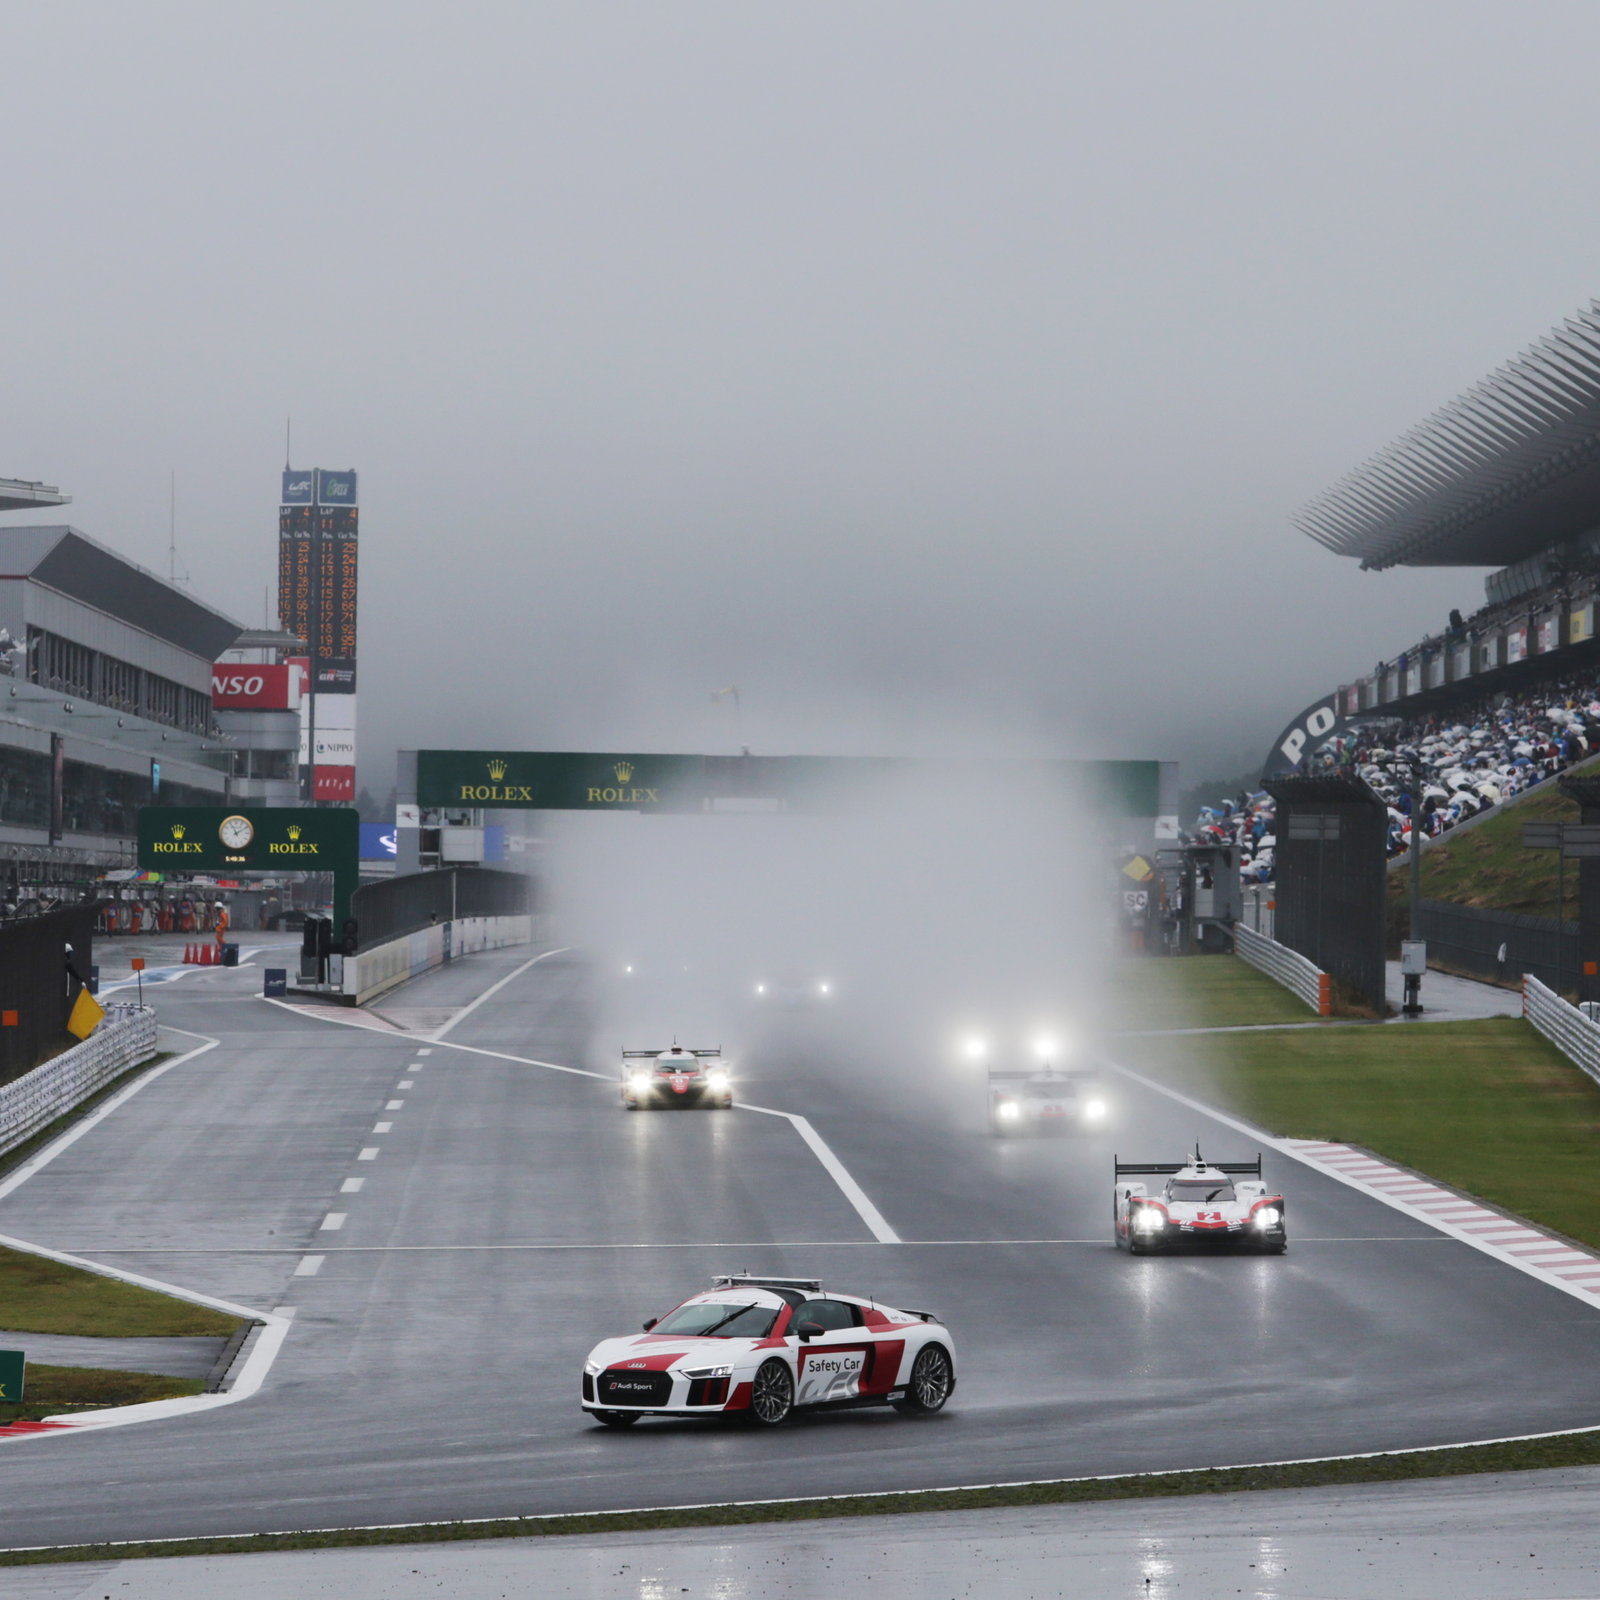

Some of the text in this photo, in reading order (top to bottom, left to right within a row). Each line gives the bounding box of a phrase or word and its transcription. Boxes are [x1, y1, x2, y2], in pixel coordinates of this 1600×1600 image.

[327, 743, 353, 752] NIPPO
[461, 785, 533, 800] ROLEX
[587, 787, 659, 802] ROLEX
[153, 842, 203, 853] ROLEX
[269, 843, 319, 854] ROLEX
[1126, 893, 1146, 908] SC
[1203, 1211, 1215, 1221] 2
[809, 1358, 861, 1374] Safety Car
